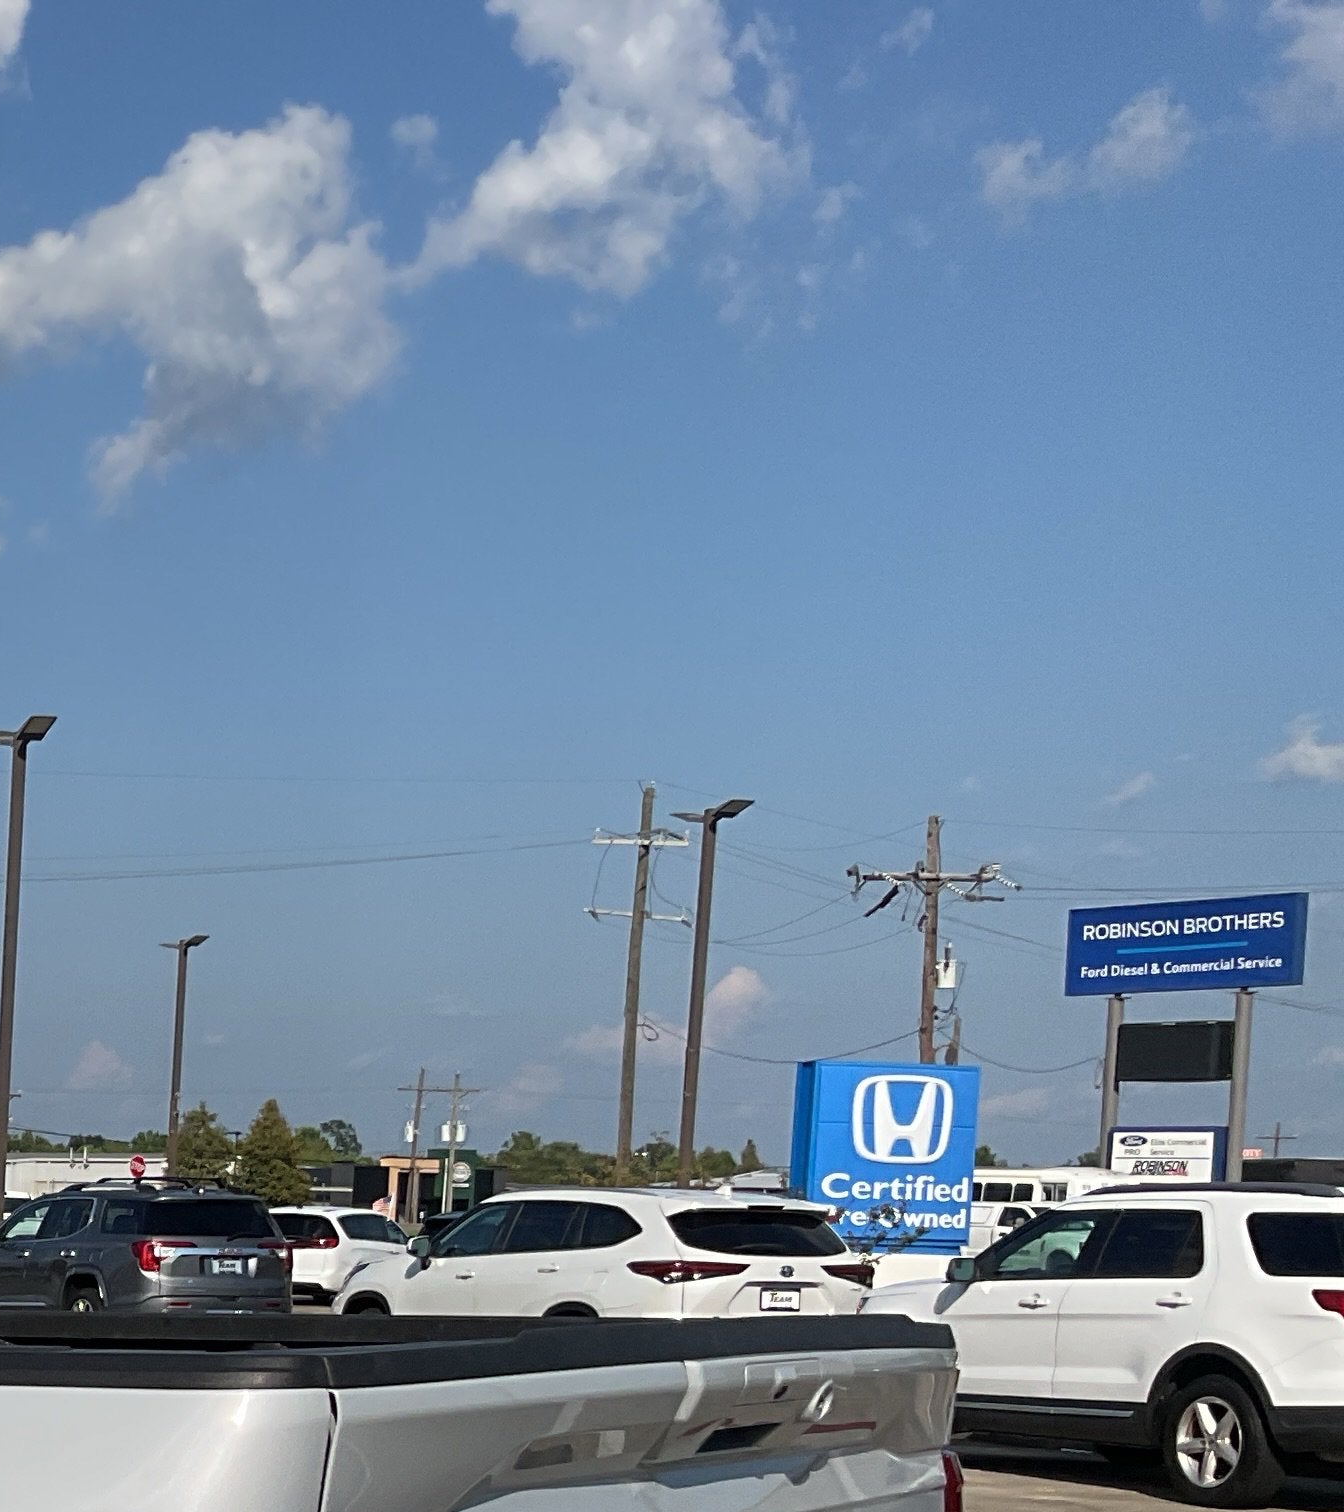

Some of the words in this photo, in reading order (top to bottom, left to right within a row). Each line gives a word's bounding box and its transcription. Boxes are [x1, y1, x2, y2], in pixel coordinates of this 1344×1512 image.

[1083, 919, 1179, 941] ROBINSON
[1183, 911, 1285, 935] BROTHERS
[1080, 964, 1107, 978] Ford
[1111, 963, 1147, 977] Diesel
[1151, 963, 1160, 974] &
[1163, 957, 1234, 974] Commercial
[1237, 956, 1282, 969] Service
[1132, 1160, 1189, 1174] ROBINSON
[821, 1172, 968, 1202] Certified
[769, 1291, 793, 1302] TEAM
